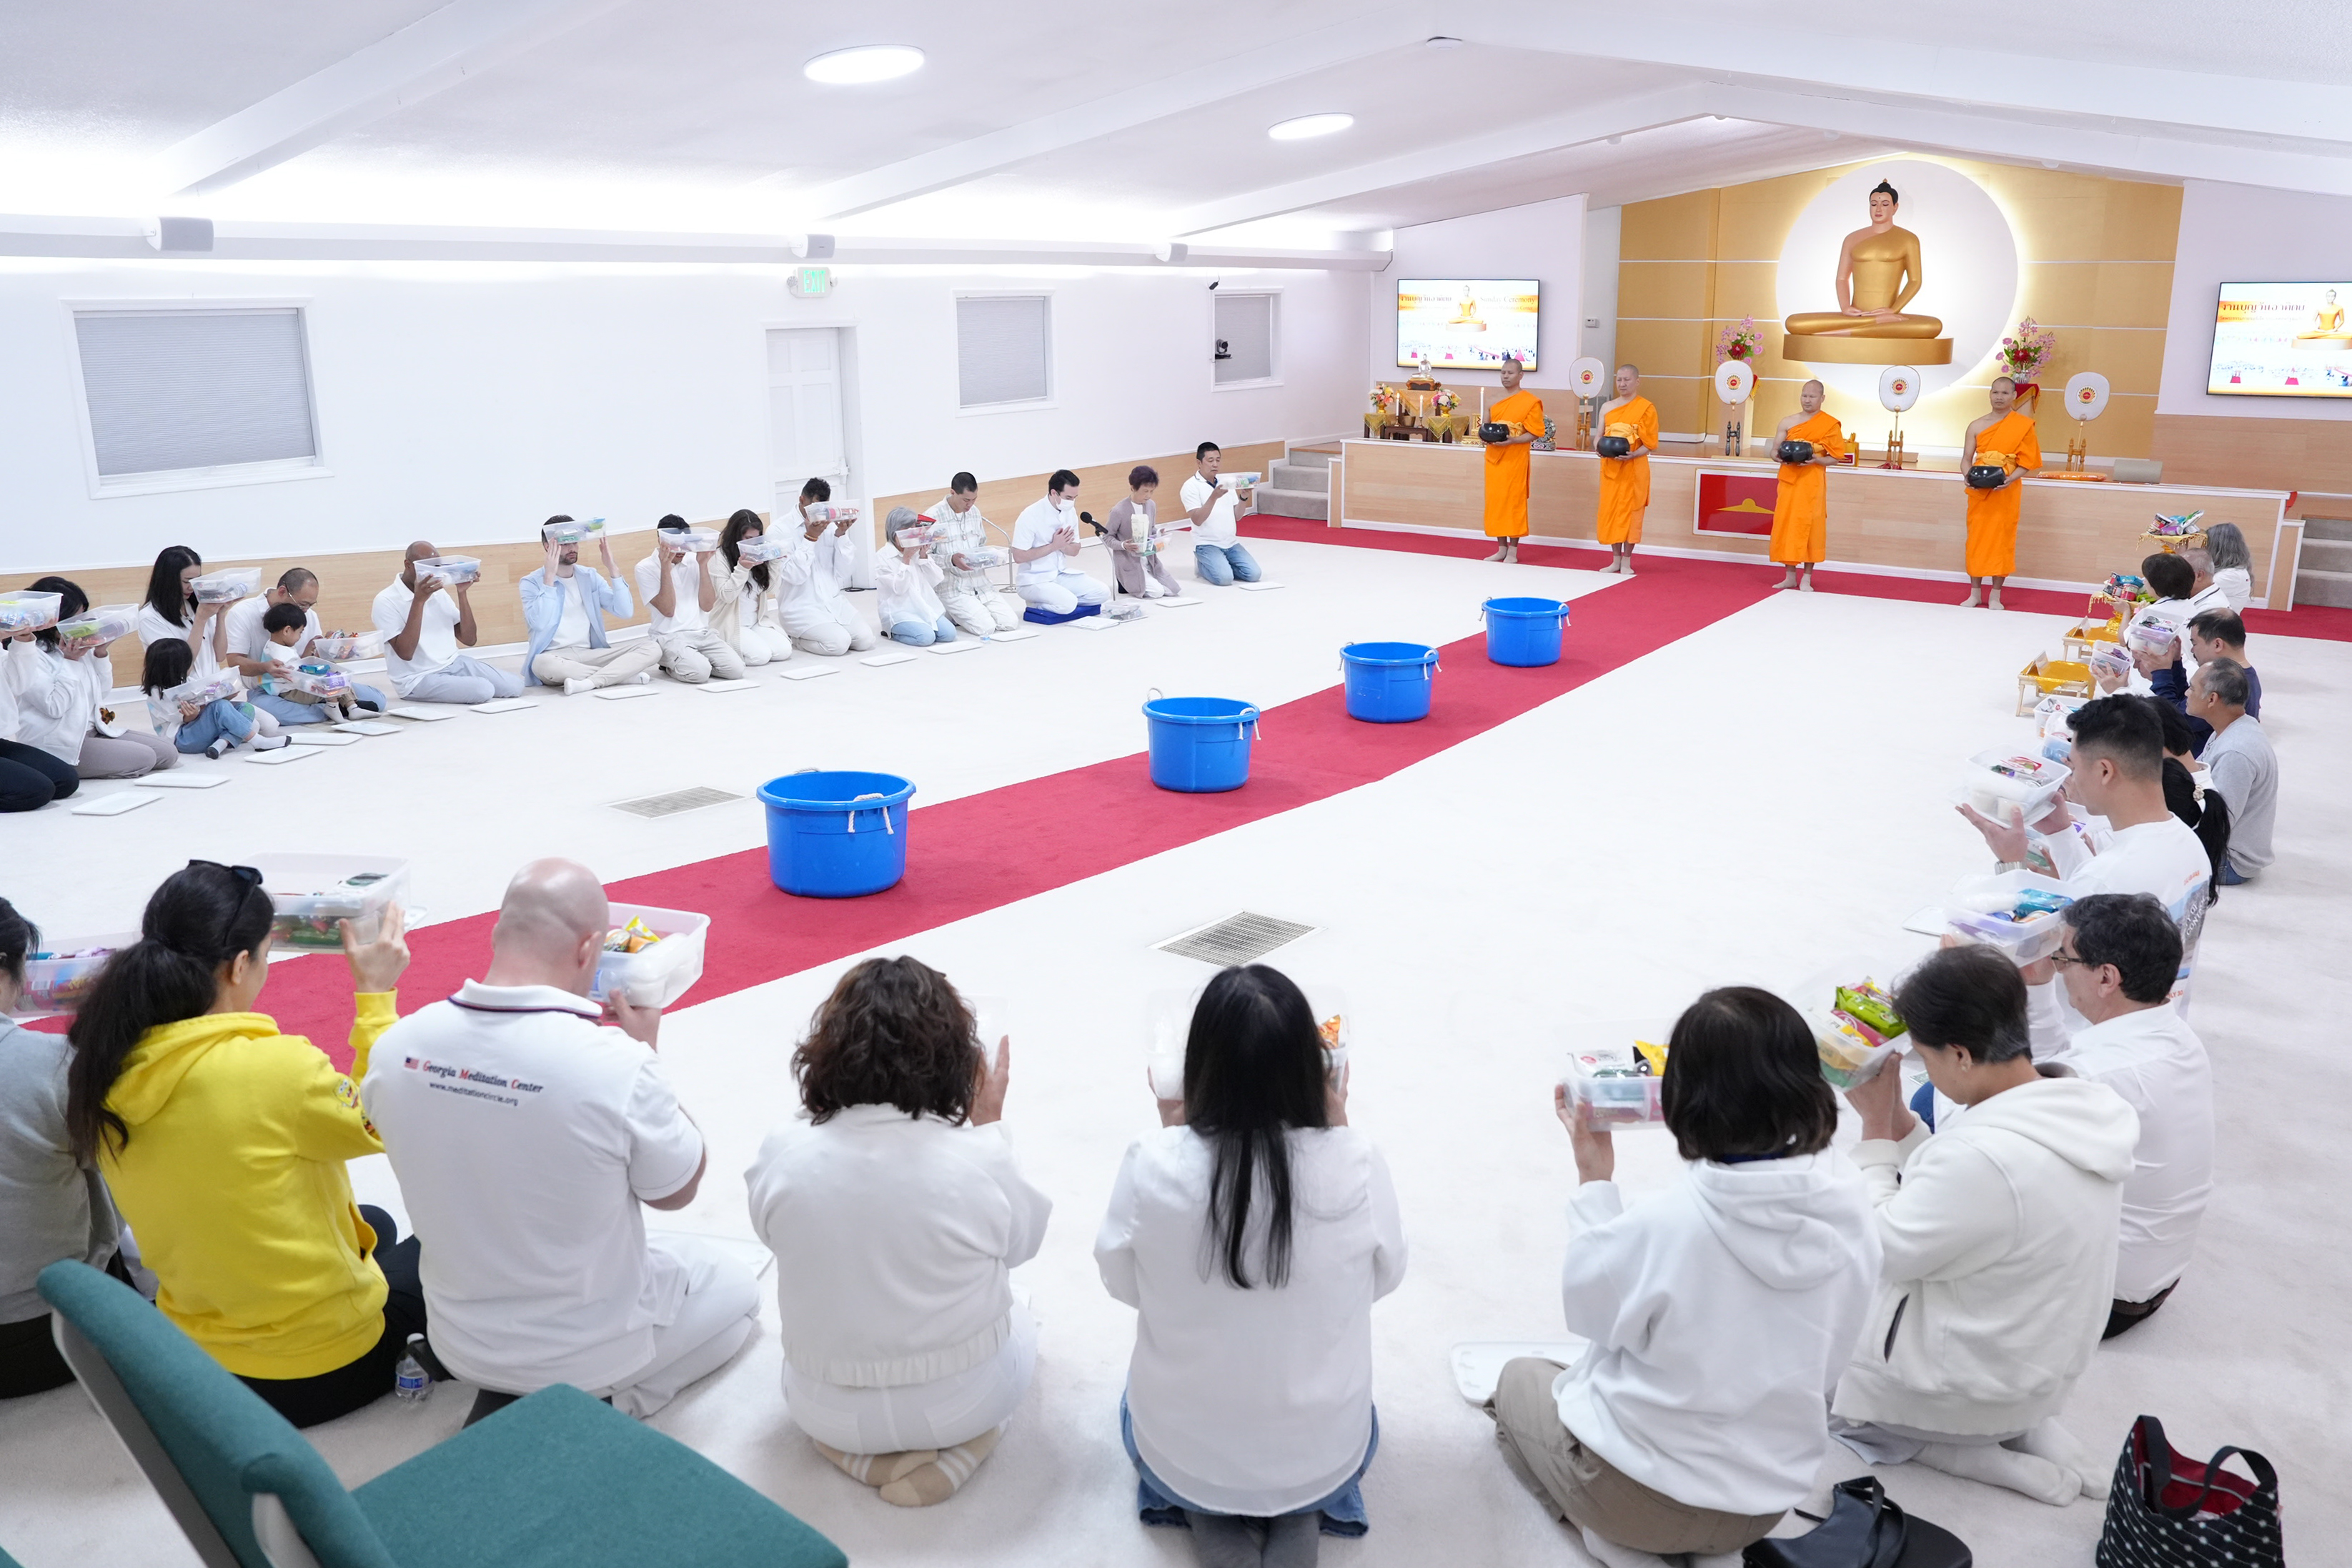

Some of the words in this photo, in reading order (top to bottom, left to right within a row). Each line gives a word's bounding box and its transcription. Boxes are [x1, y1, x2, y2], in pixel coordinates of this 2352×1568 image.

[804, 269, 825, 293] EXIT
[1480, 295, 1502, 304] Sunday
[1504, 295, 1535, 304] Ceremony
[422, 1060, 457, 1078] Georgia
[459, 1068, 507, 1088] Meditation
[511, 1078, 544, 1093] Center
[430, 1081, 519, 1106] www.meditationcircle.org
